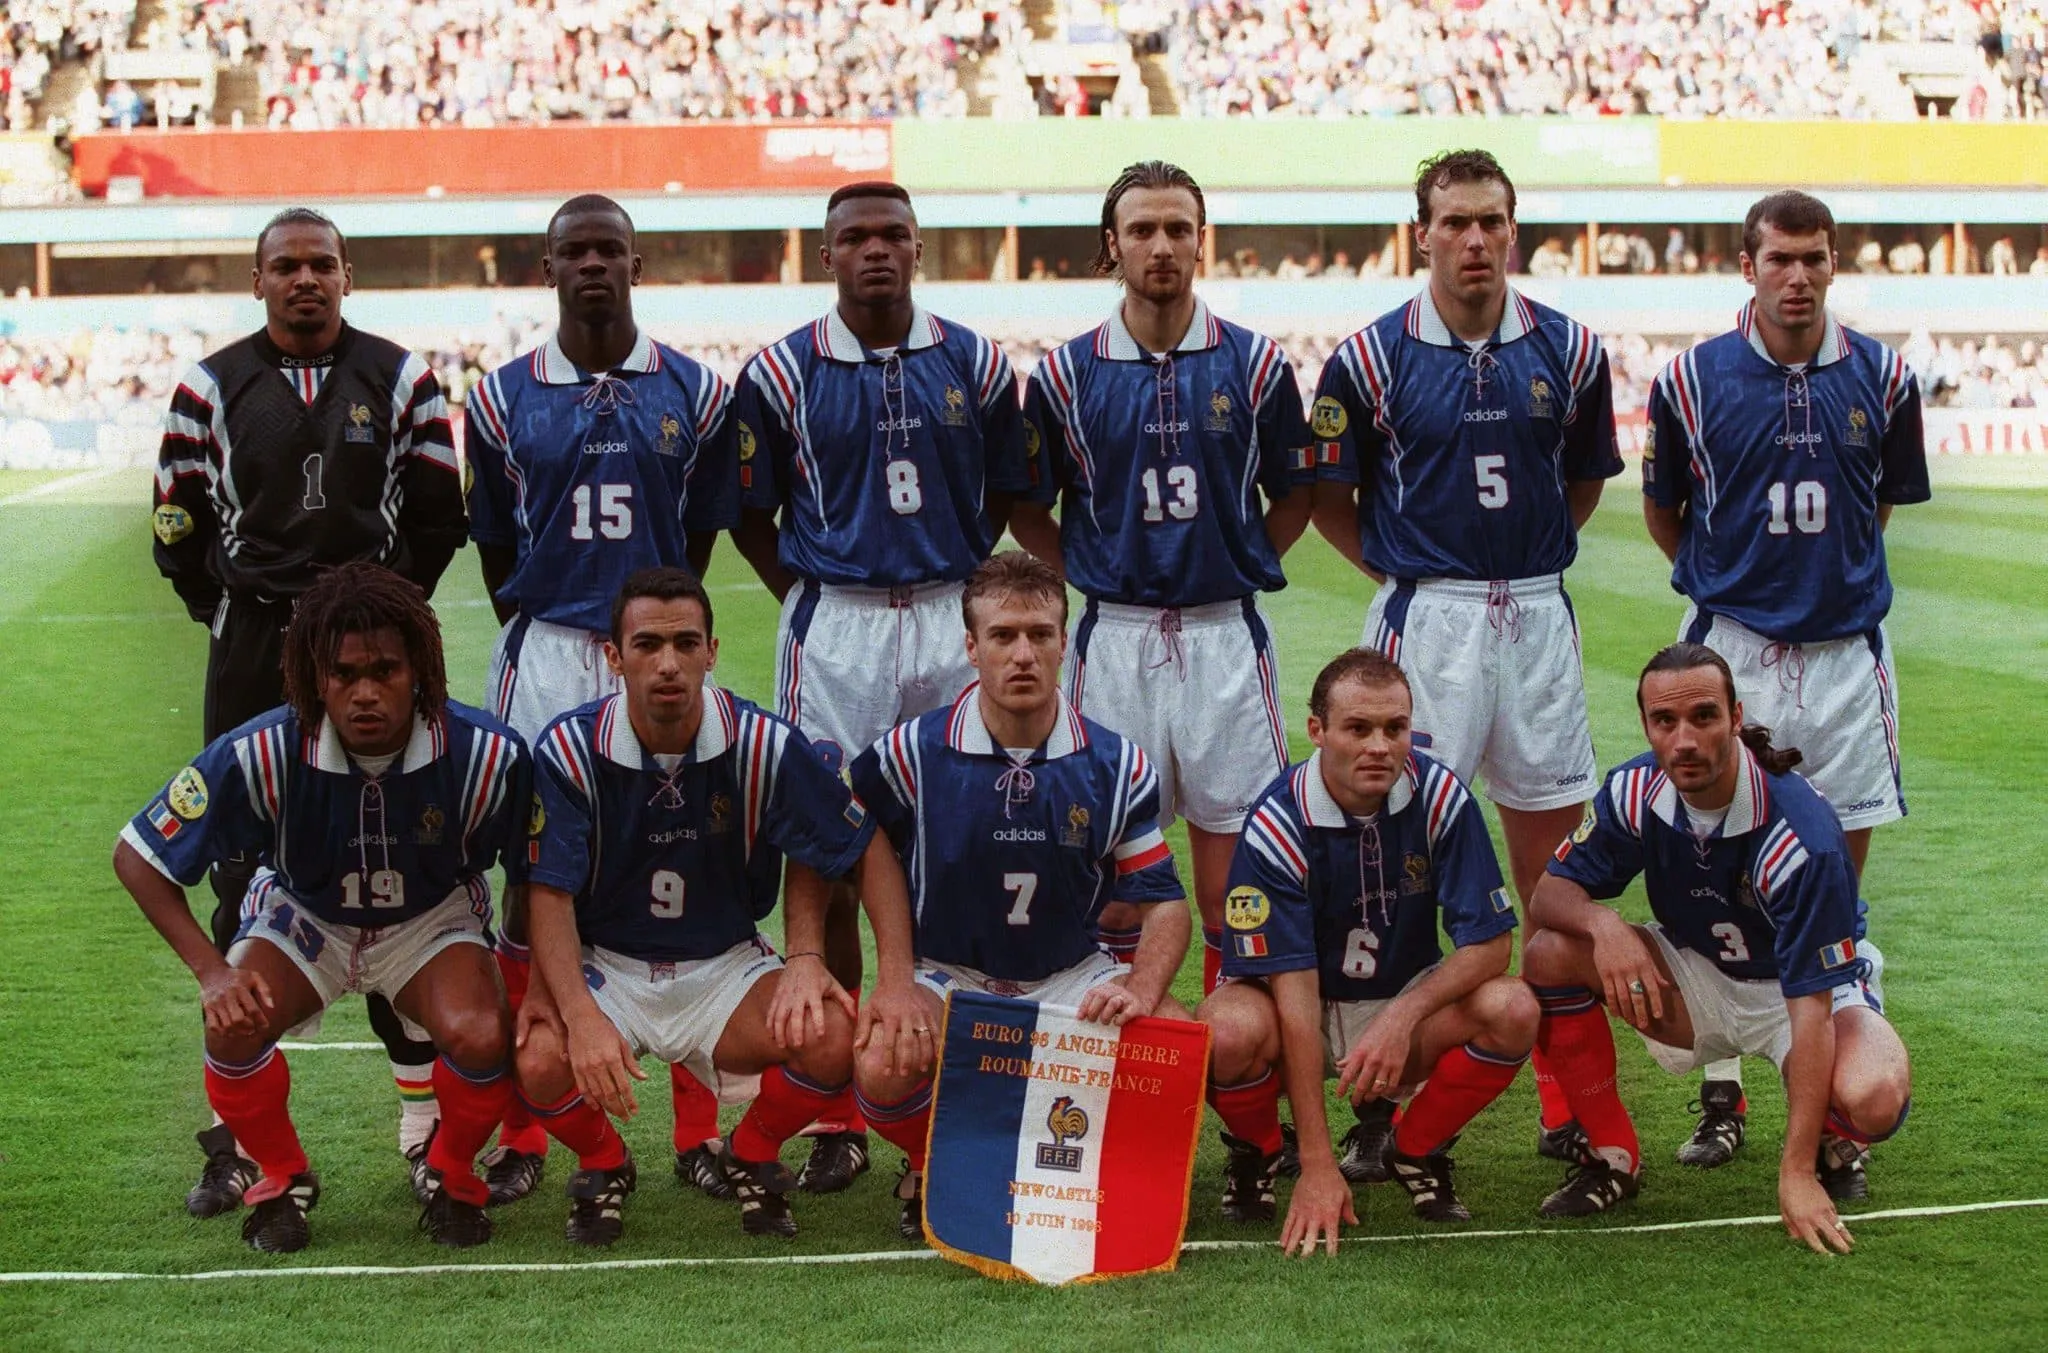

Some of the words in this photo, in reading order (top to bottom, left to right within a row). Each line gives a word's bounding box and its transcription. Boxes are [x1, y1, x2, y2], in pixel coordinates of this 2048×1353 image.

[281, 353, 335, 367] adidas
[877, 416, 923, 432] adidas
[1144, 420, 1190, 434] addas
[1463, 407, 1508, 423] adidas
[584, 439, 629, 455] adidas
[303, 453, 326, 510] 1
[886, 459, 923, 515] 8
[1141, 465, 1199, 521] 13
[1474, 454, 1509, 510] 5
[571, 483, 633, 540] 15
[1768, 481, 1826, 535] 10
[1556, 773, 1588, 787] adidas
[1848, 798, 1884, 812] adidas
[648, 828, 698, 845] adidas
[993, 827, 1046, 842] adidas
[340, 869, 405, 909] 19
[650, 869, 685, 919] 9
[1003, 872, 1038, 925] 7
[1342, 927, 1379, 979] 6
[1711, 922, 1750, 962] 3
[972, 1021, 1024, 1045] EURO
[1055, 1032, 1181, 1066] ANGLETERRE
[979, 1054, 1163, 1096] ROUMANIE-FRANCE
[1007, 1180, 1105, 1204] NEWCASTLE
[1006, 1211, 1020, 1225] 10
[1026, 1212, 1066, 1229] JUIN
[1071, 1217, 1103, 1233] 1996
